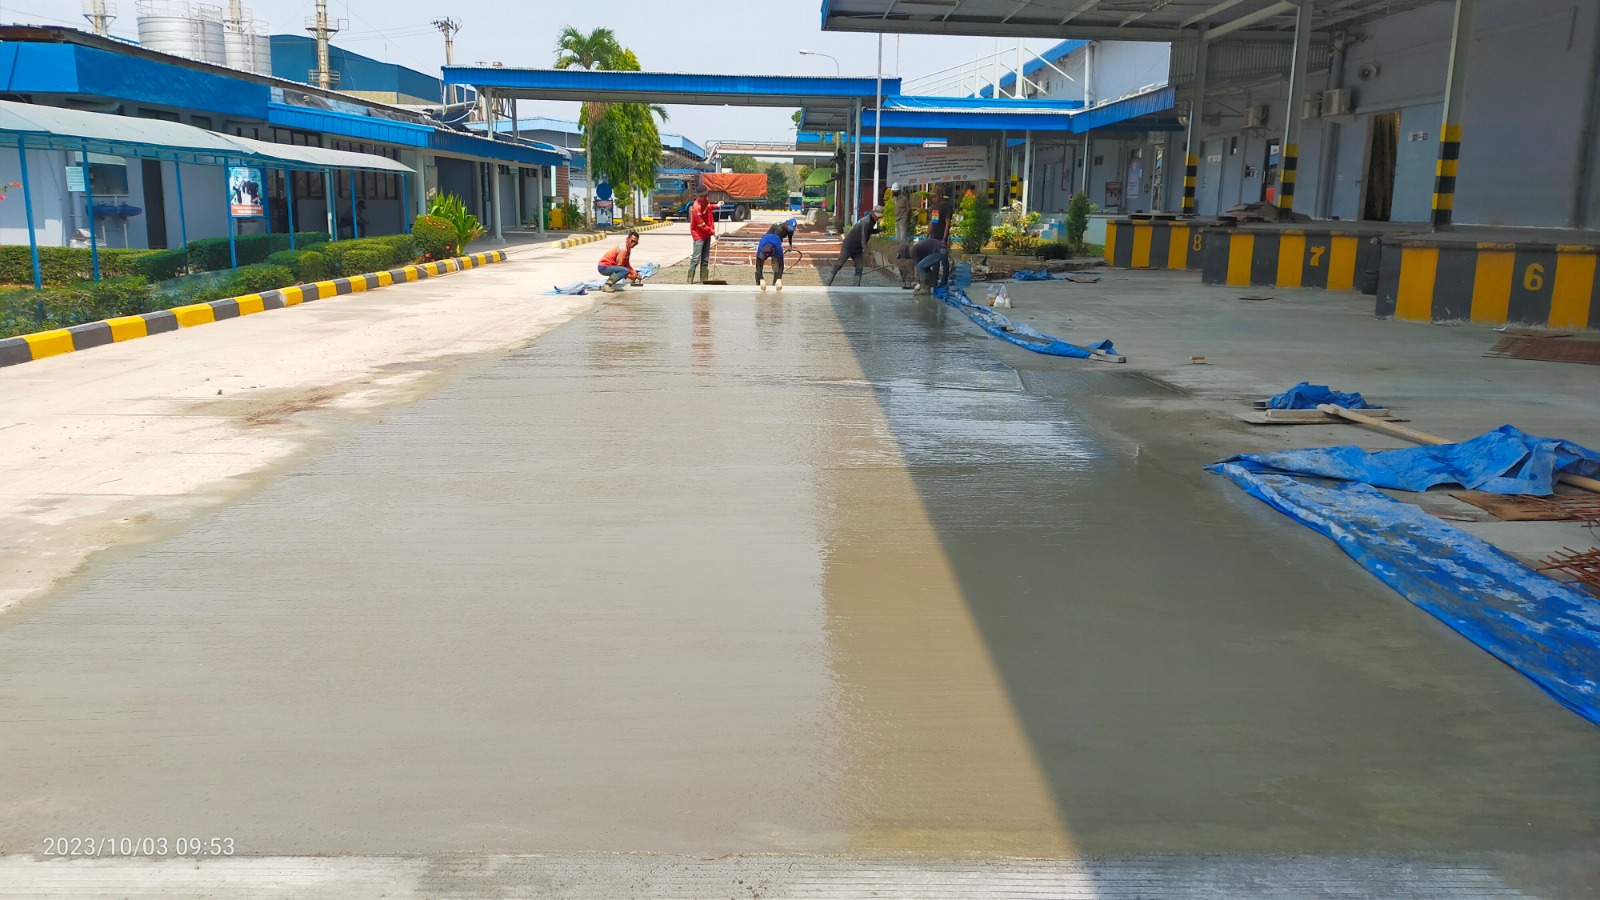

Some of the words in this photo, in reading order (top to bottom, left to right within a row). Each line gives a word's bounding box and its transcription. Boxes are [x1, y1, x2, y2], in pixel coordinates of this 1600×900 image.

[1193, 233, 1202, 251] 8
[1310, 246, 1325, 266] 7
[1524, 263, 1545, 291] 6
